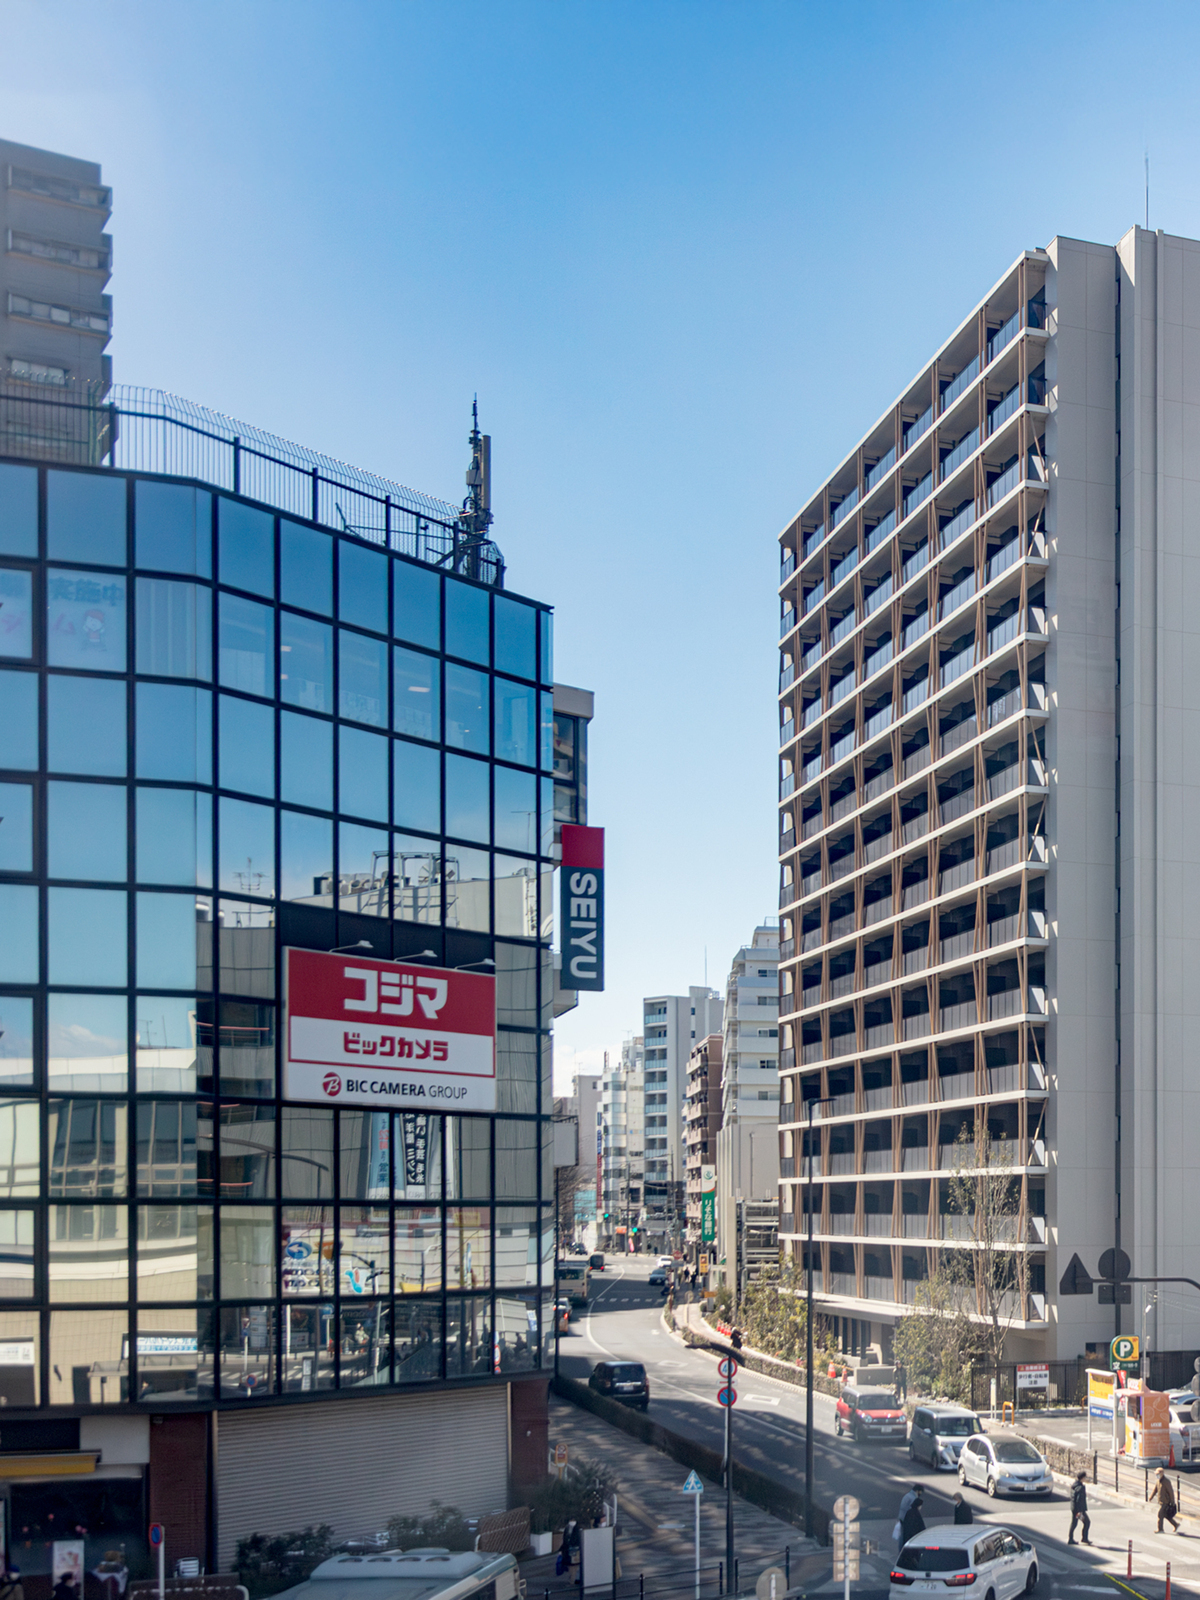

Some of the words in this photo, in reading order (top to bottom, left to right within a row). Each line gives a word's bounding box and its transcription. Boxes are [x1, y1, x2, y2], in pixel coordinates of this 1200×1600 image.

[569, 872, 598, 979] SEIYU
[344, 966, 448, 1019] コジマ
[343, 1031, 449, 1061] ビックカメラ
[346, 1079, 368, 1094] BIC
[370, 1081, 426, 1096] CAMERA
[428, 1085, 468, 1099] GROUP
[1120, 1341, 1131, 1357] P
